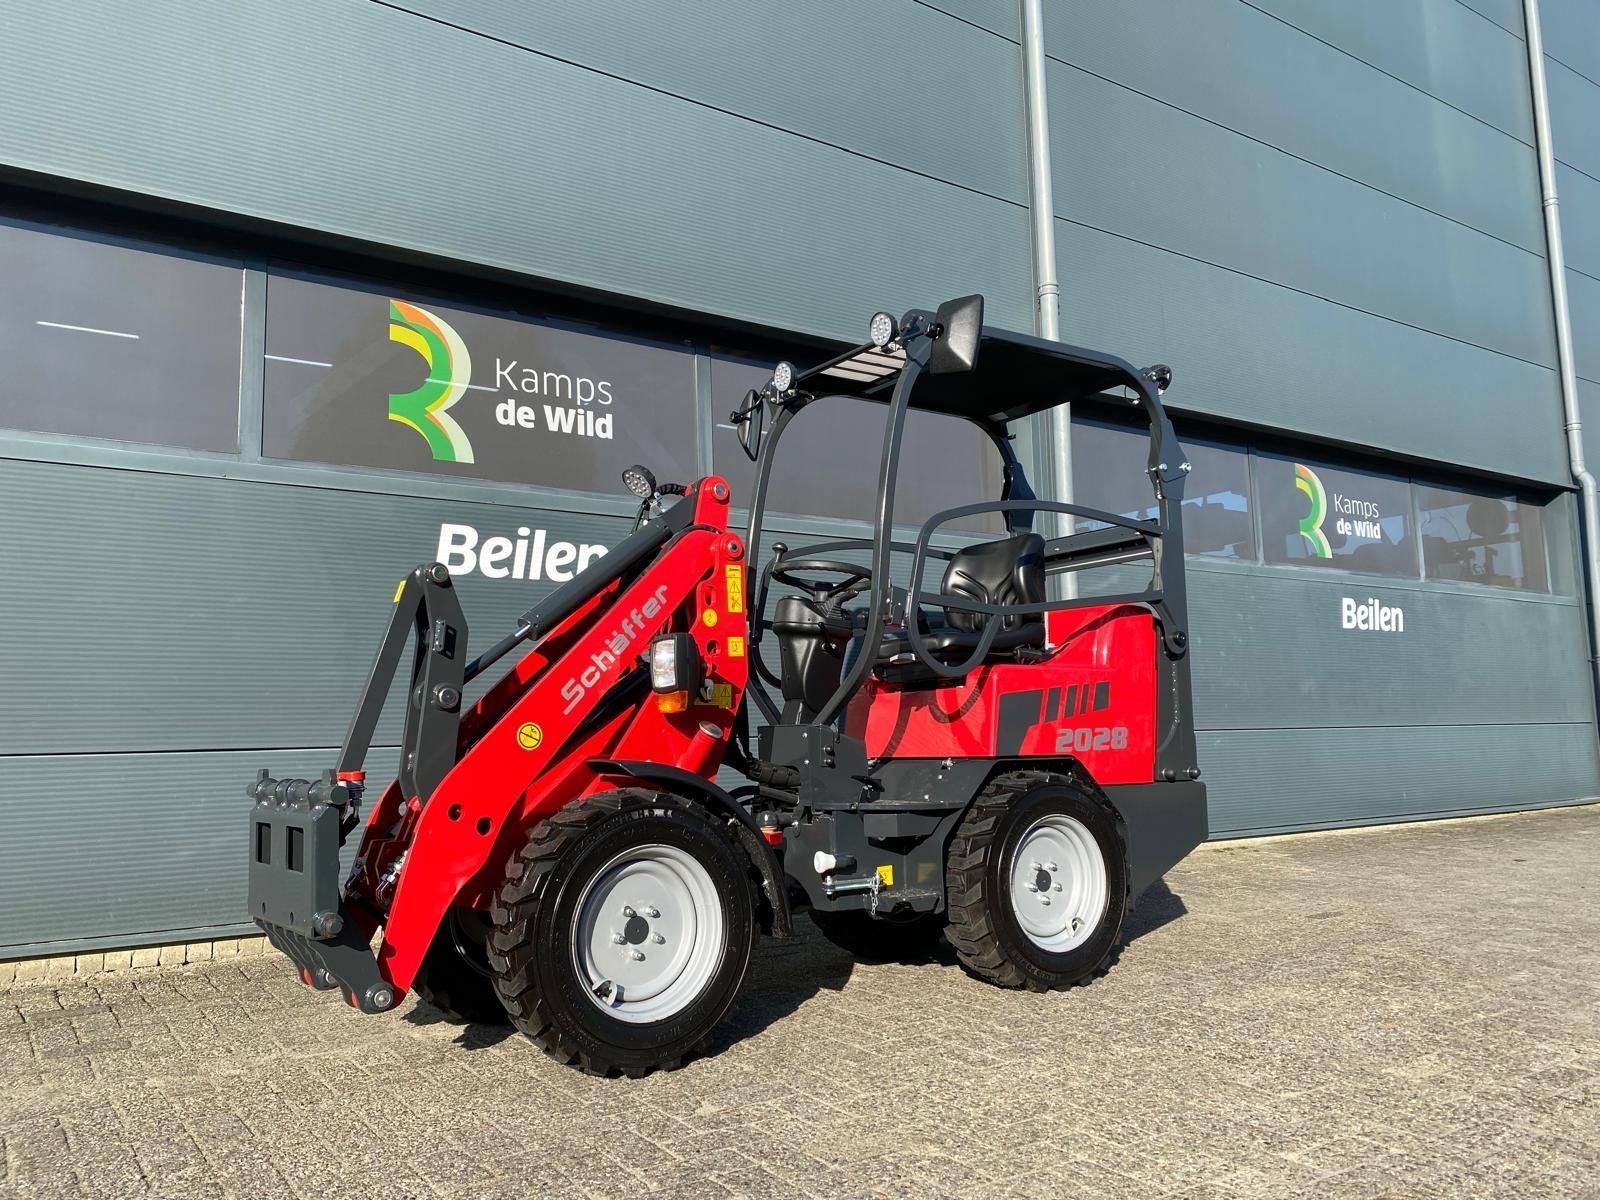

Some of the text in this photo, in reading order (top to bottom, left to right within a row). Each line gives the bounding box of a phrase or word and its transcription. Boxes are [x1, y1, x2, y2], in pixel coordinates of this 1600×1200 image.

[495, 358, 613, 405] Kamps
[495, 398, 613, 439] de Wild
[1333, 493, 1380, 520] Kamps
[1336, 517, 1382, 540] de Wild
[1341, 597, 1404, 633] Beilen
[560, 584, 669, 717] Schäffer
[1055, 726, 1129, 753] 2028
